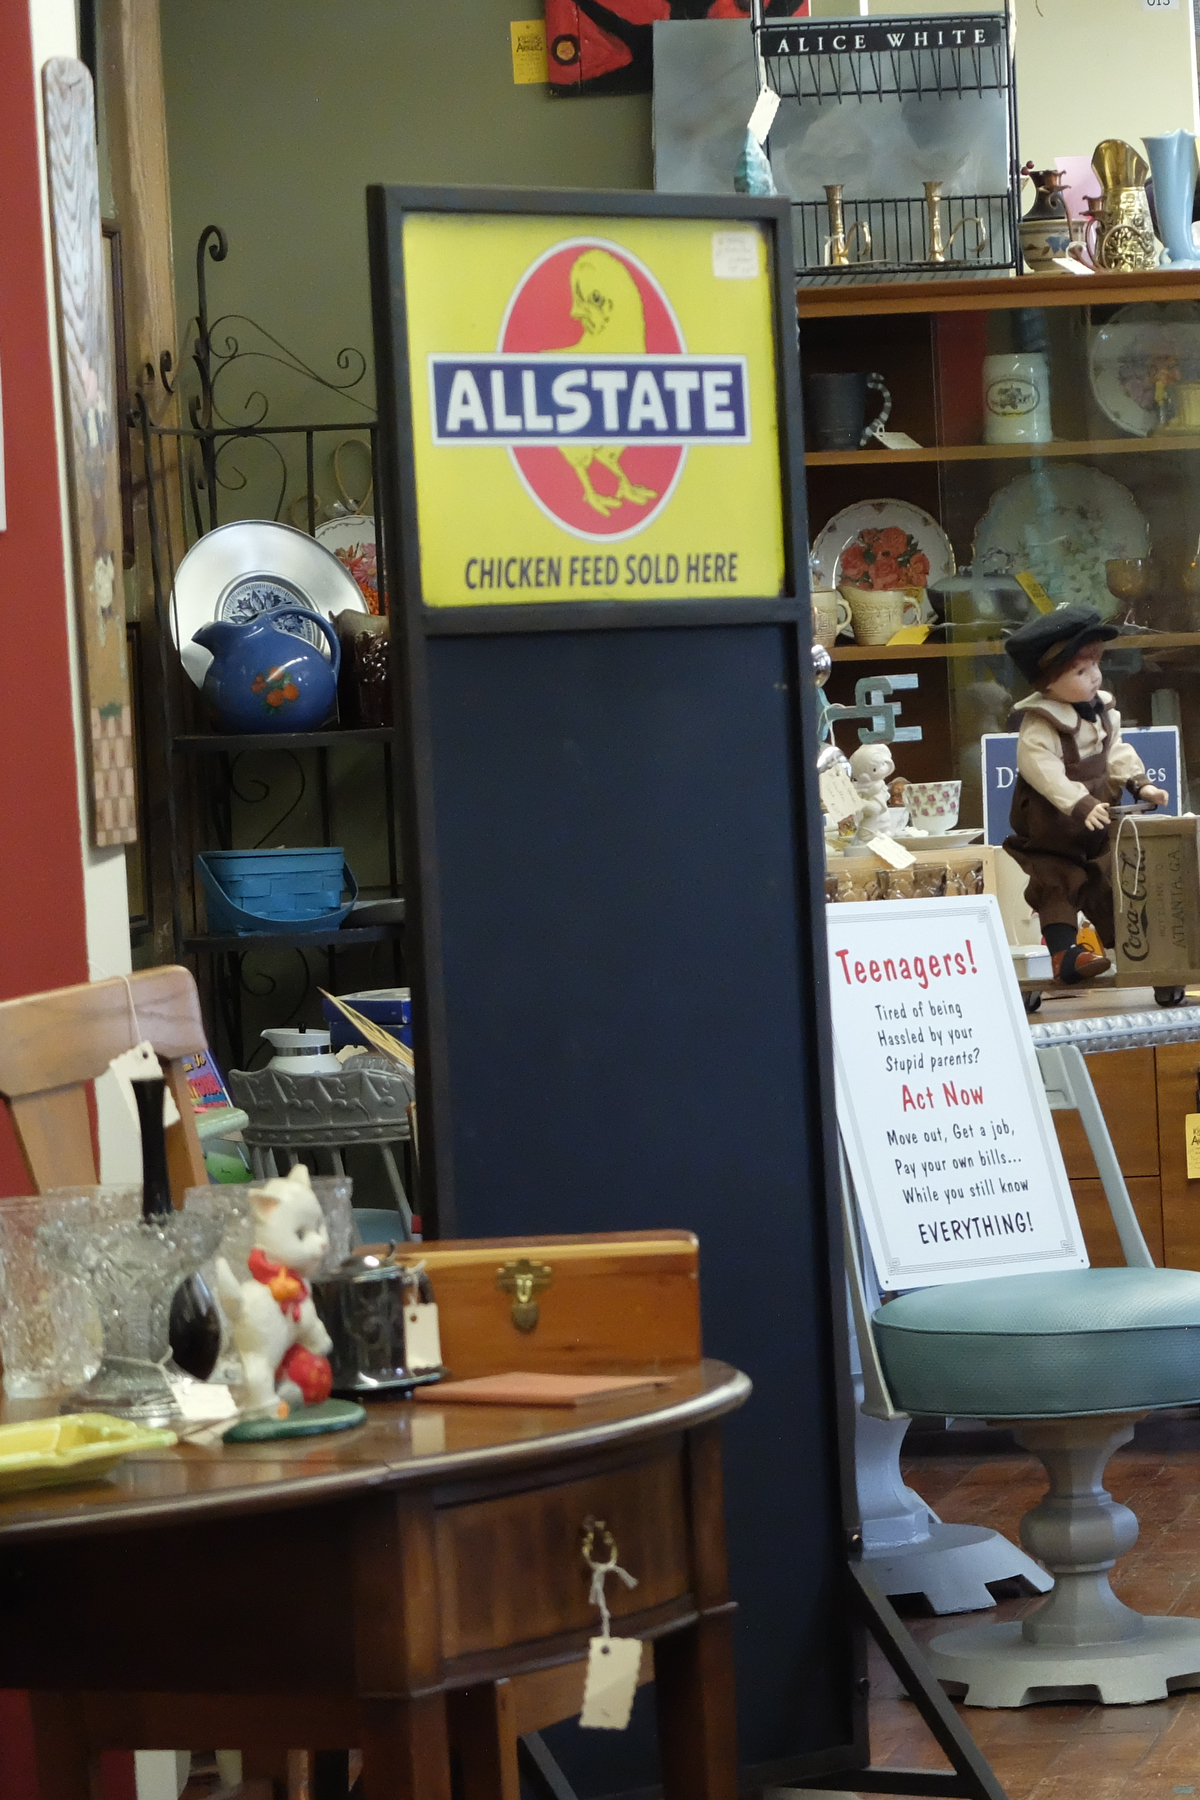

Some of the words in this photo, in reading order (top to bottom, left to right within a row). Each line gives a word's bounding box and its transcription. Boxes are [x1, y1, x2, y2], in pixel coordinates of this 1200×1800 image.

[777, 34, 867, 53] ALICE
[886, 28, 986, 48] WHITE
[446, 368, 736, 433] ALLSTATE
[465, 557, 562, 590] CHICKEN
[569, 555, 619, 587] FEED
[625, 553, 679, 586] SOLD
[686, 552, 738, 584] HERE
[835, 939, 978, 989] Teenagers!
[874, 1002, 907, 1021] Tired
[912, 1001, 924, 1018] of
[928, 1000, 963, 1018] being
[877, 1026, 925, 1047] Hassled
[928, 1026, 943, 1046] by
[947, 1027, 973, 1045] your
[886, 1053, 924, 1075] Stupid
[930, 1047, 980, 1072] parents?
[902, 1084, 934, 1112] Act
[942, 1080, 984, 1107] Now
[886, 1129, 918, 1146] Move
[924, 1127, 948, 1143] out,
[952, 1123, 974, 1139] Get
[979, 1126, 987, 1137] a
[990, 1118, 1015, 1140] job,
[894, 1158, 916, 1178] Pay
[921, 1159, 947, 1177] your
[952, 1156, 974, 1169] own
[978, 1148, 1022, 1167] bills...
[902, 1186, 939, 1204] While
[944, 1187, 965, 1205] you
[969, 1178, 996, 1197] still
[998, 1177, 1029, 1194] know
[918, 1211, 1034, 1244] EVERYTHING!
